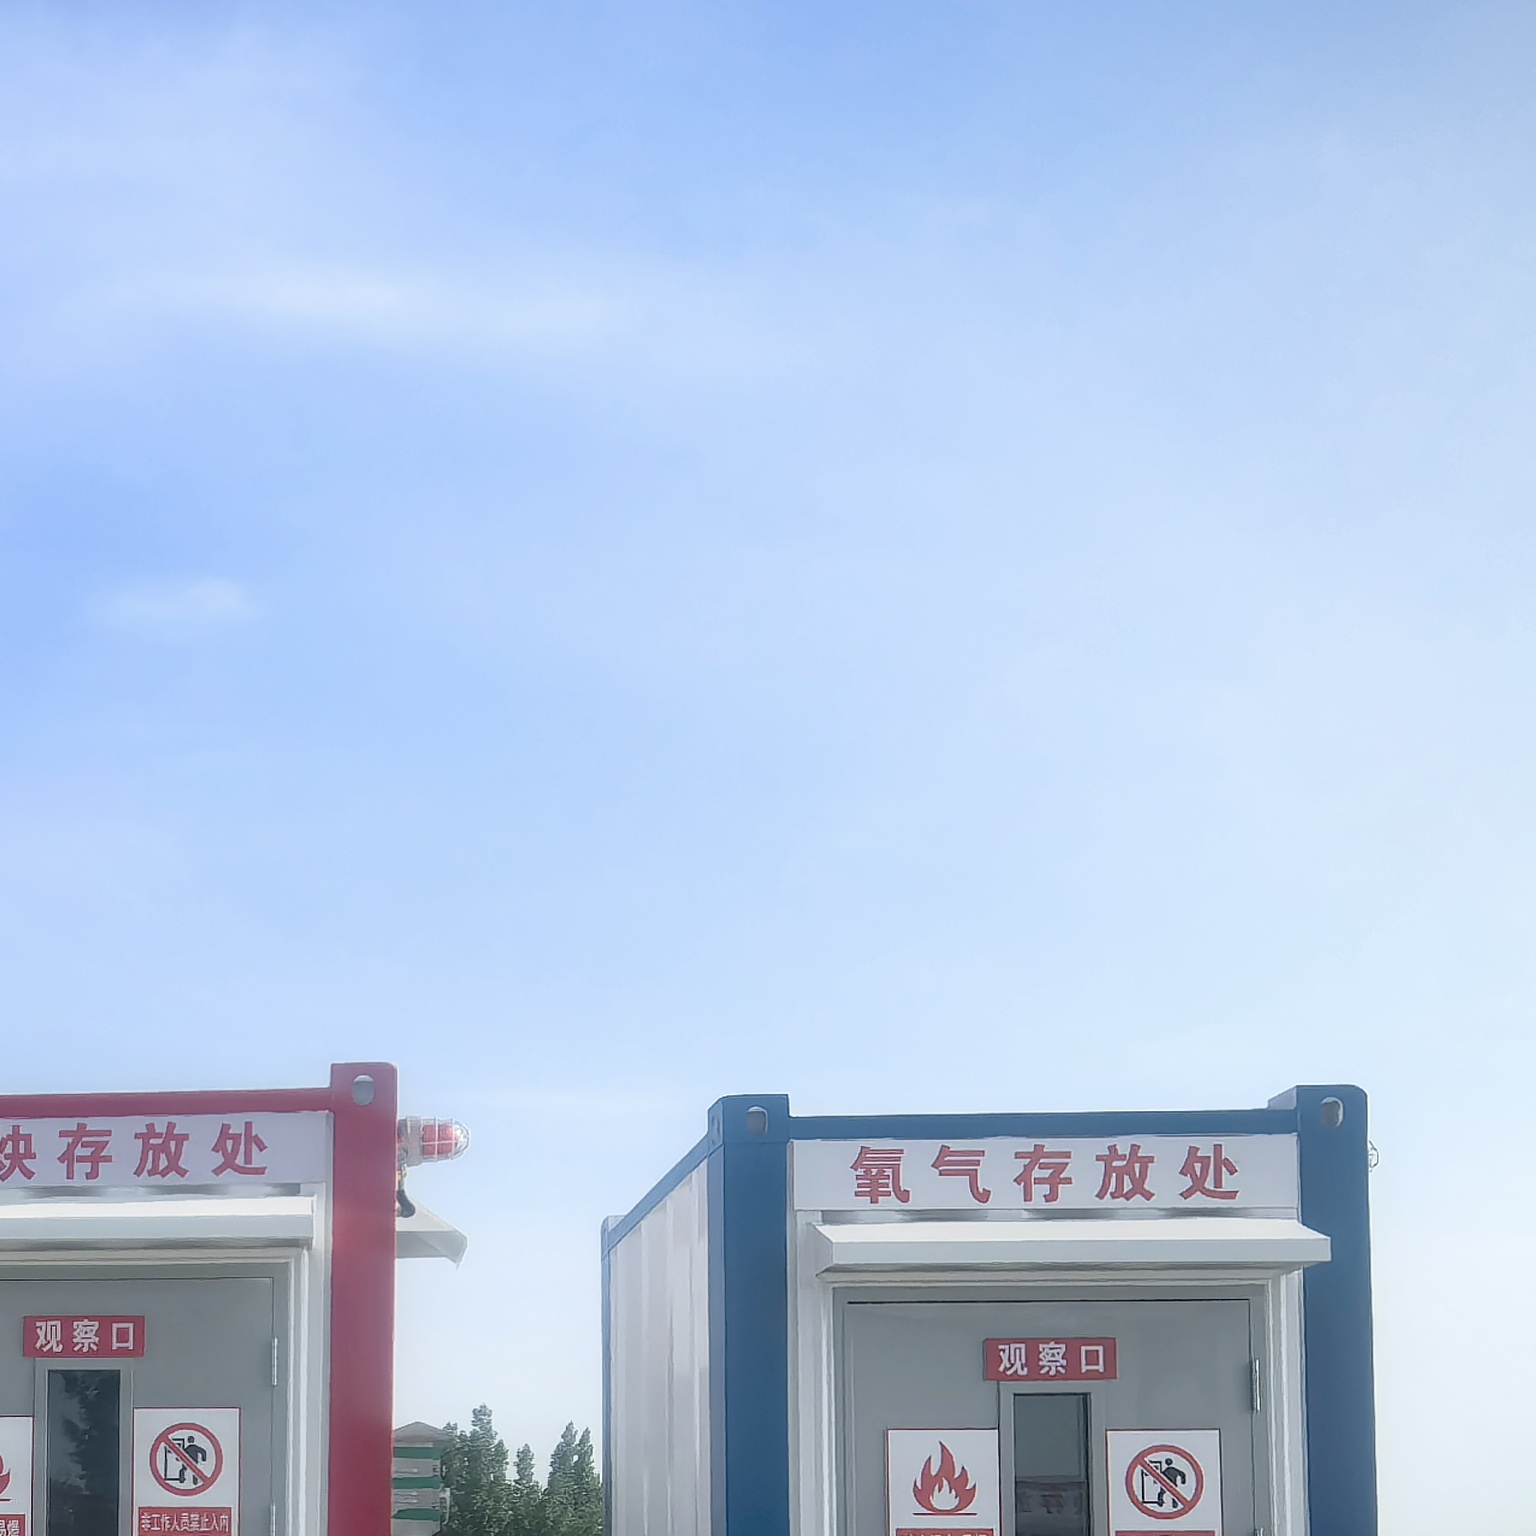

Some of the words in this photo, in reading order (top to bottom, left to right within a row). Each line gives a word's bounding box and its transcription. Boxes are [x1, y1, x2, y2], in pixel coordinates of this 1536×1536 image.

[850, 1144, 1239, 1204] 氧气存放处
[34, 1319, 135, 1353] 观察口
[997, 1341, 1105, 1376] 观察口
